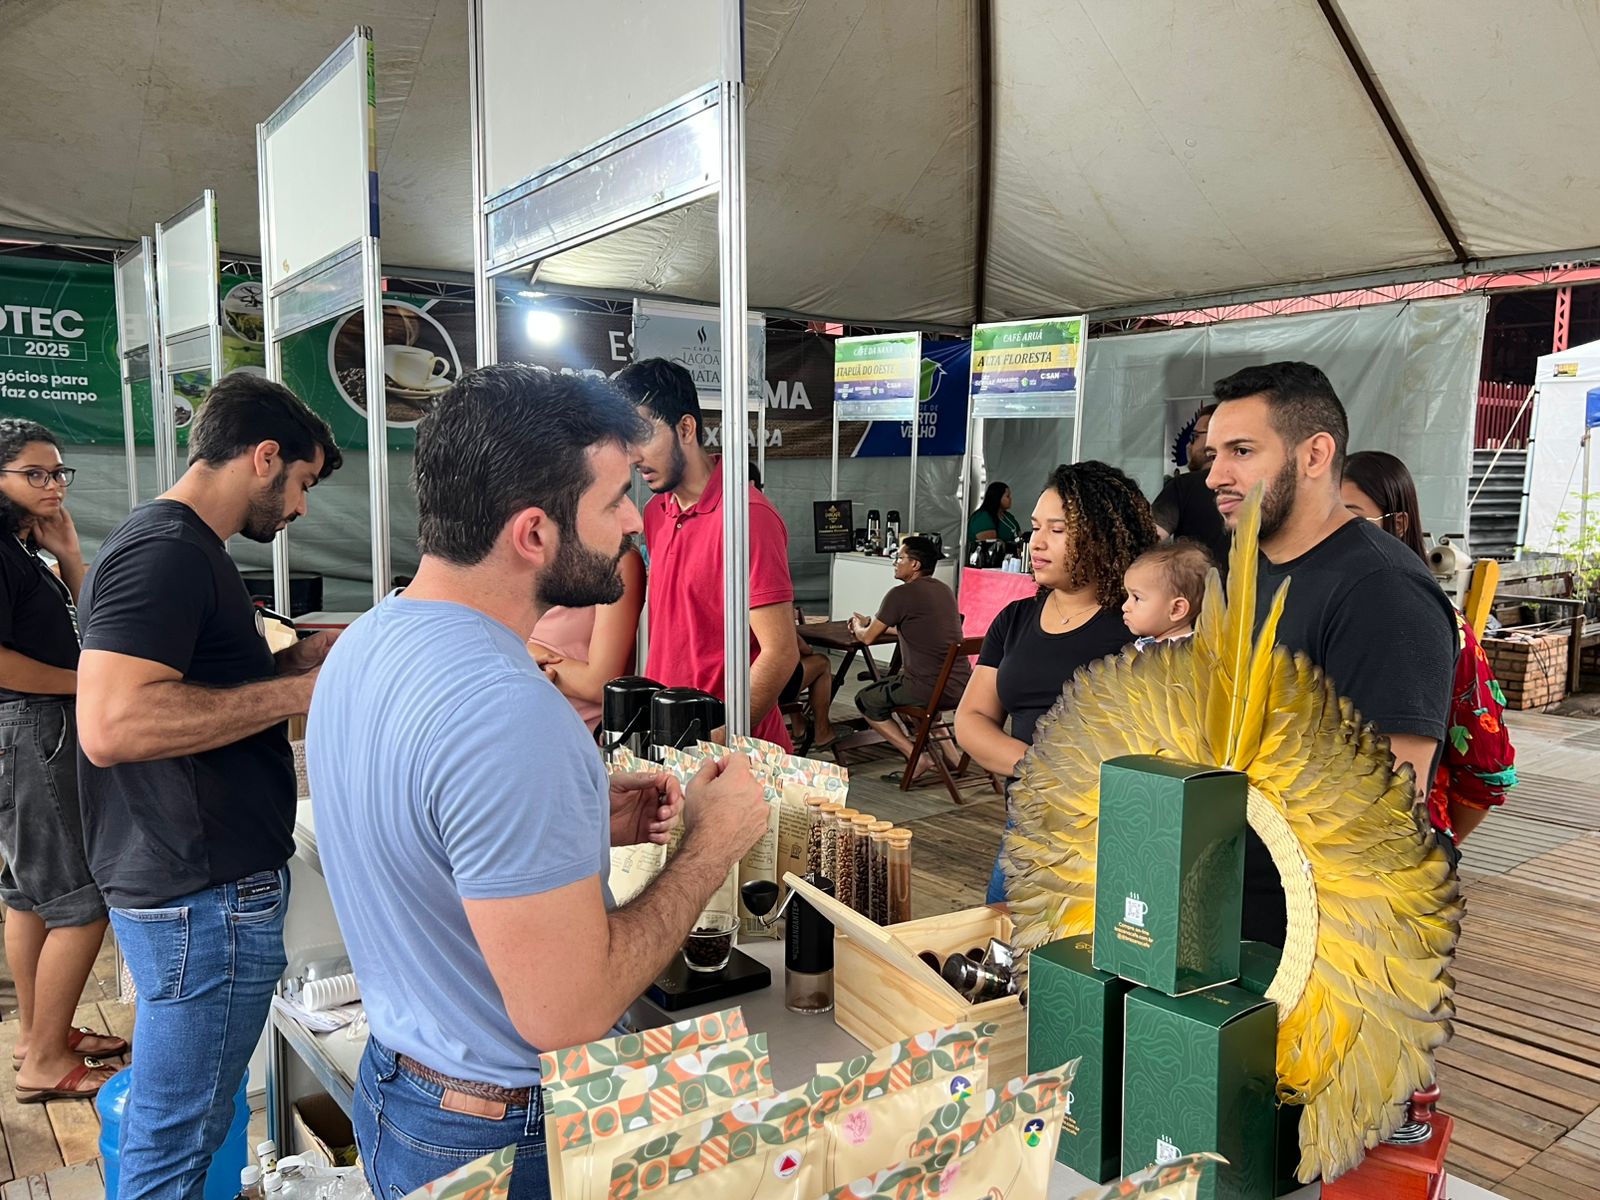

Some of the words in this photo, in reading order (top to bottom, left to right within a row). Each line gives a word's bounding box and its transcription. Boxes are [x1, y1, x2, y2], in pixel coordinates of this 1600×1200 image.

[0, 304, 84, 338] TEC
[24, 341, 70, 357] 2025
[977, 355, 1000, 367] ALTA
[1003, 351, 1052, 366] FLORESTA
[862, 365, 873, 376] DO
[51, 375, 88, 388] para
[1, 385, 26, 398] faz
[28, 389, 39, 399] o
[41, 390, 97, 404] campo
[901, 425, 936, 438] VEHO
